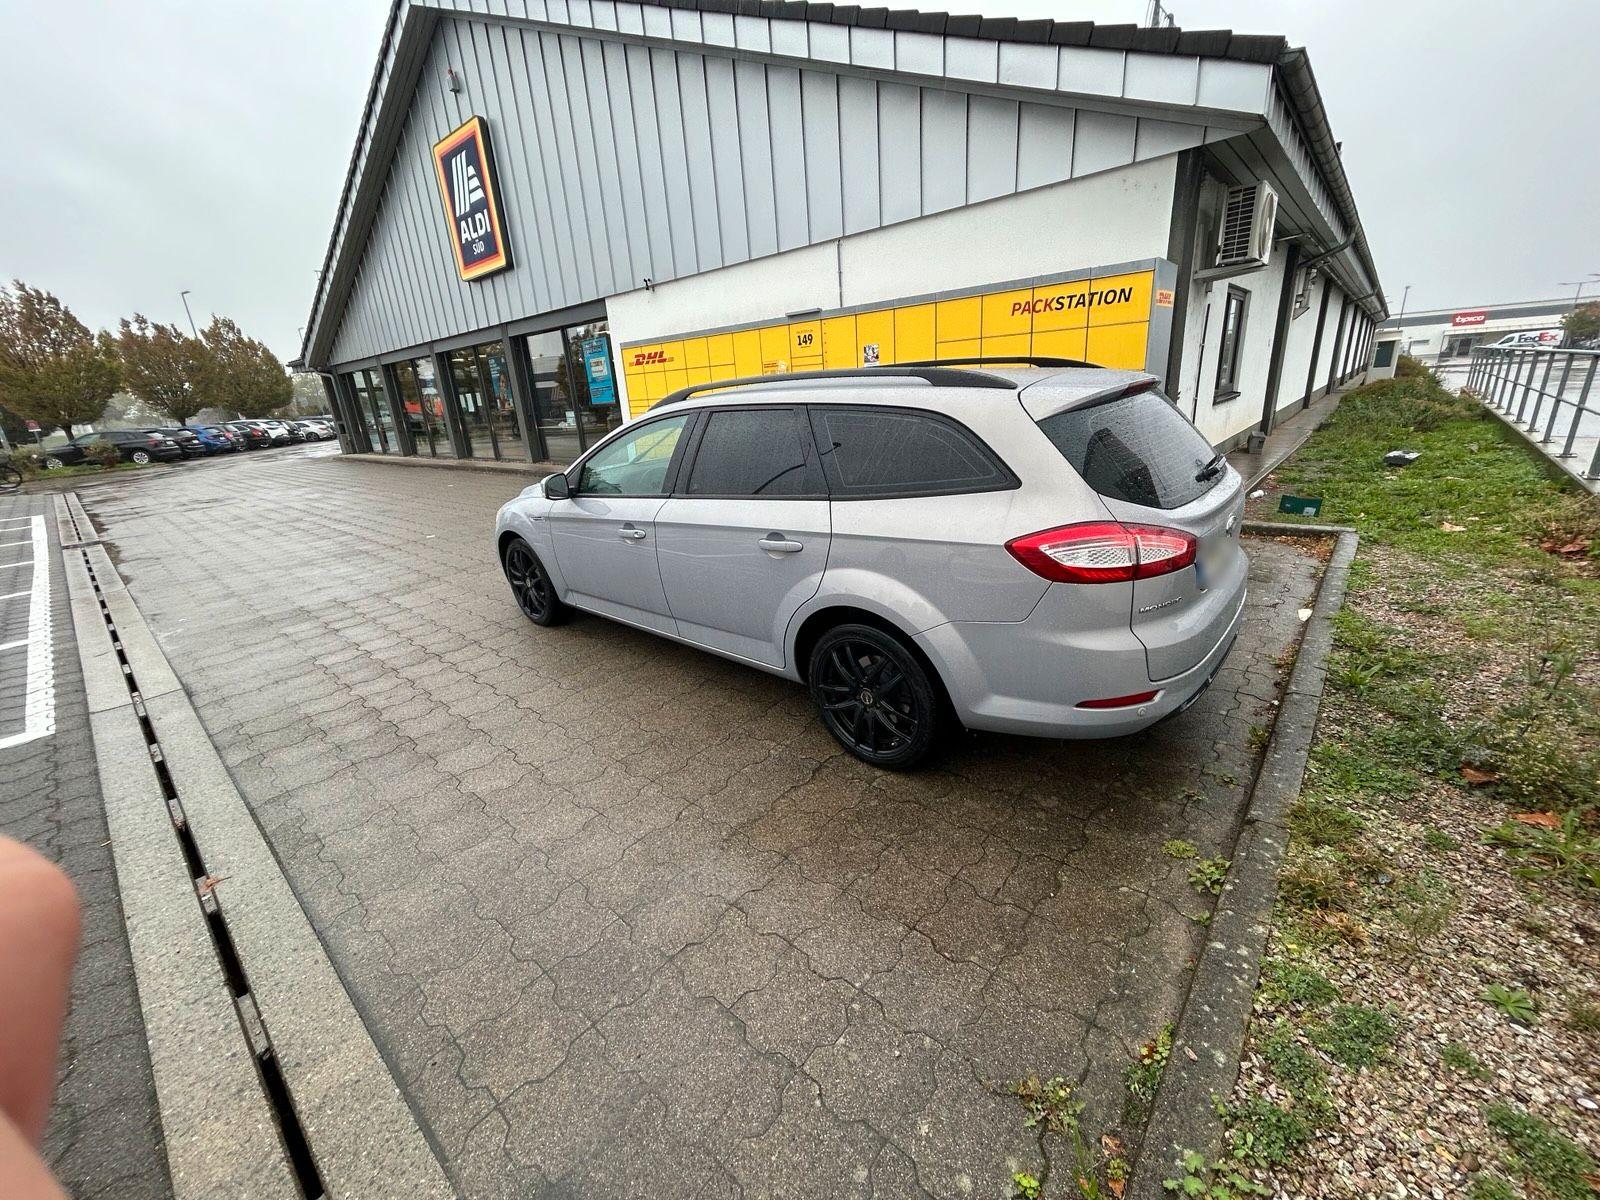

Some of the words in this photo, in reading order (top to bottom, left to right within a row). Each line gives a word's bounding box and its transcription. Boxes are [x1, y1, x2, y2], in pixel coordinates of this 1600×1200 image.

[461, 209, 491, 244] ALDI
[472, 239, 485, 255] SÜD
[1011, 286, 1133, 317] PACKSTATION
[797, 333, 813, 346] 149
[1518, 331, 1559, 344] FedEx
[634, 350, 668, 367] DHL
